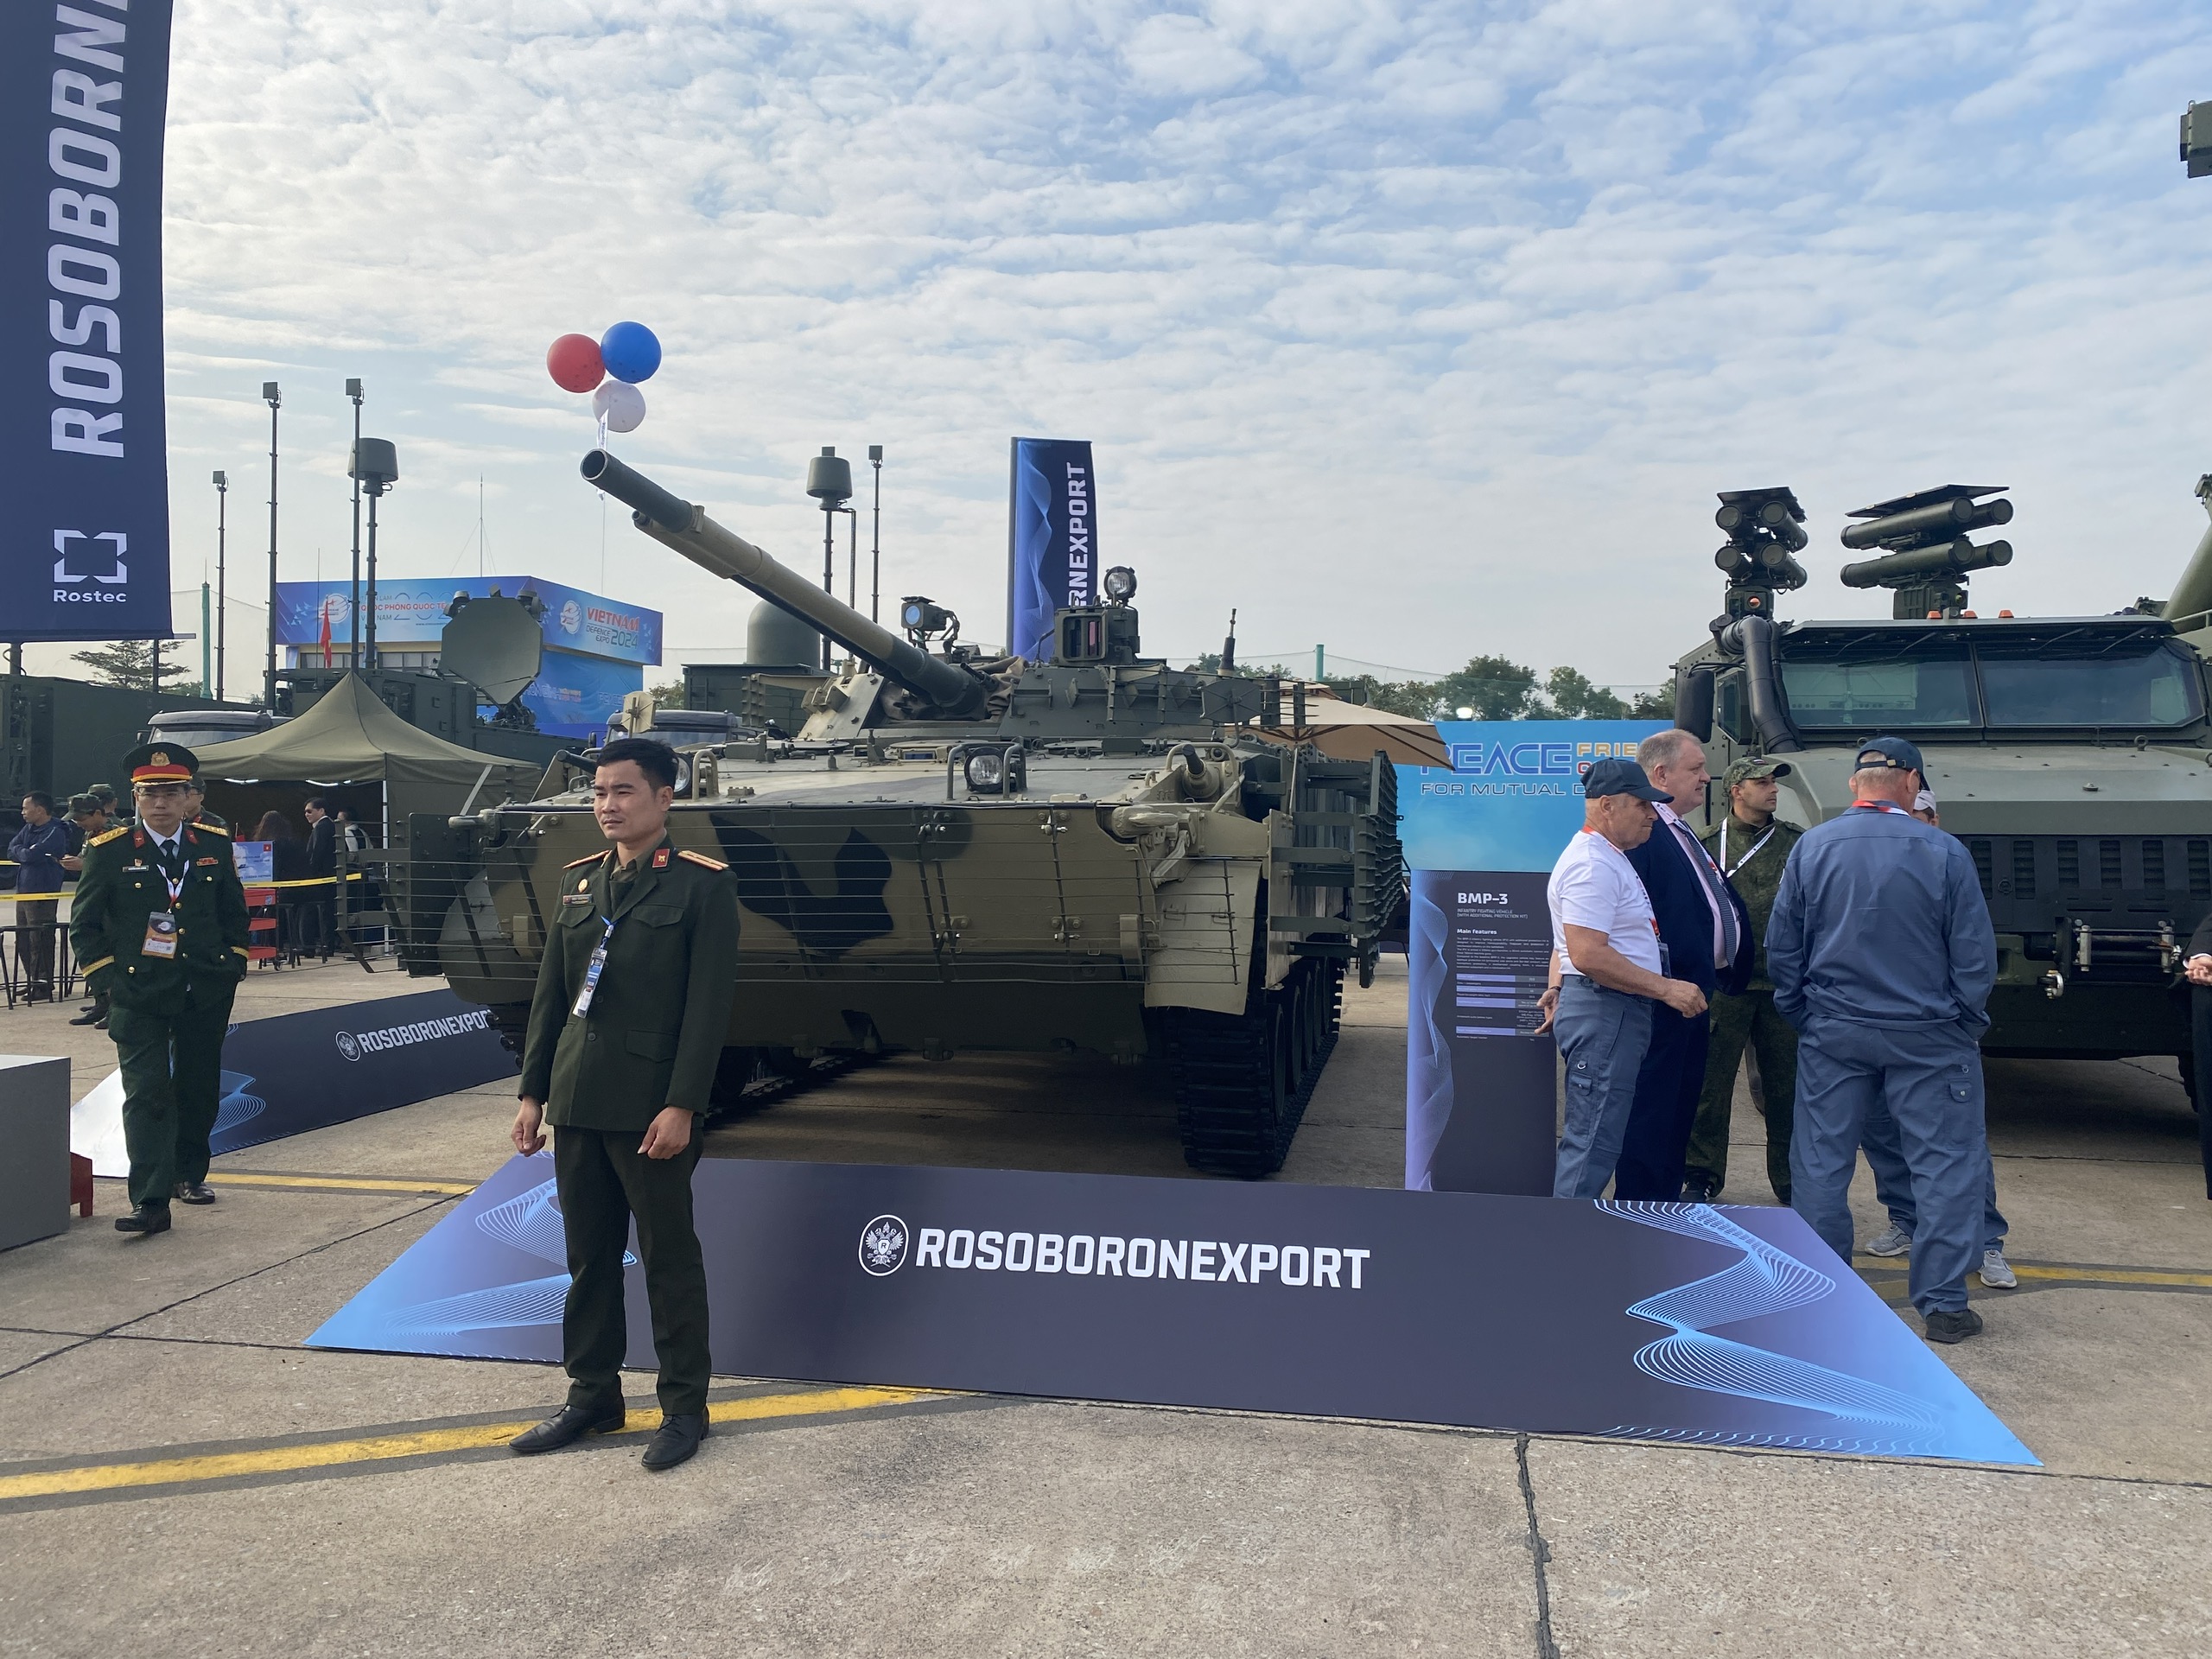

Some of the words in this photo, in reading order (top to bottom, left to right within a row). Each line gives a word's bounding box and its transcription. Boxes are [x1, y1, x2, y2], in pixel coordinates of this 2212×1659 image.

[48, 0, 128, 458] ROSOBORN
[1066, 461, 1089, 606] RNEXPORT
[53, 588, 127, 603] Rostec
[587, 607, 639, 632] VIETNAM
[587, 625, 611, 637] DEFENCE
[610, 629, 638, 650] 2024
[1577, 742, 1638, 757] FRIE
[1421, 783, 1465, 796] FOR
[1471, 783, 1566, 796] MUTUAL
[1458, 892, 1509, 905] BMP-3
[356, 1009, 490, 1052] ROSOBORONEXPOR
[915, 1228, 1370, 1289] ROSOBORONEXPORT
